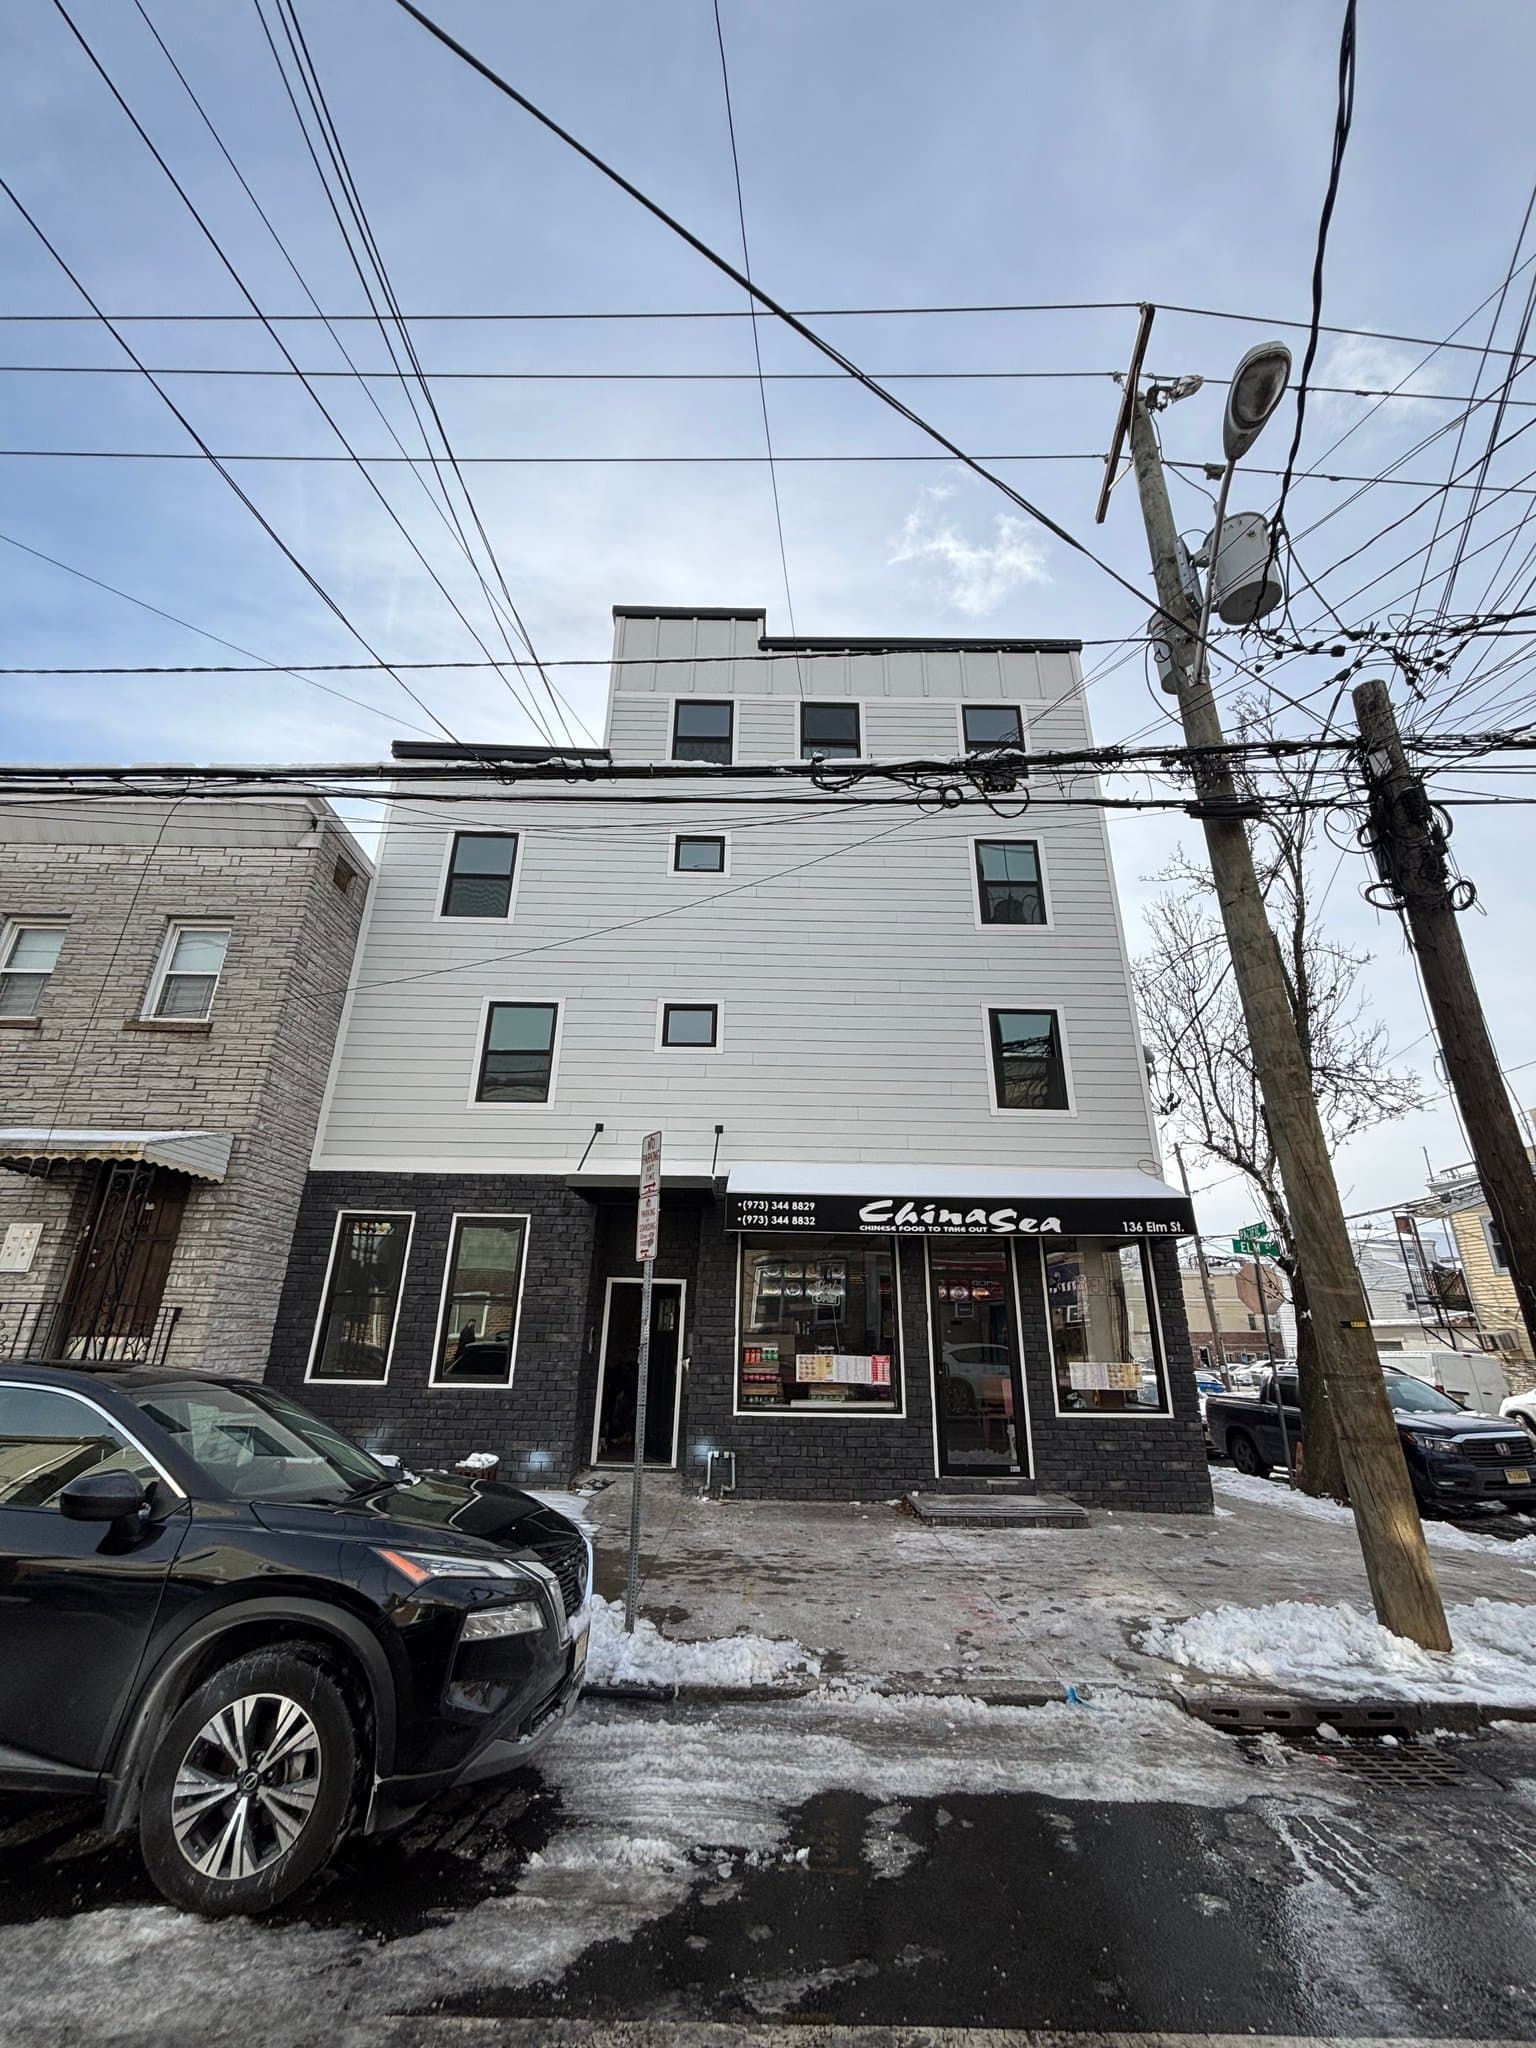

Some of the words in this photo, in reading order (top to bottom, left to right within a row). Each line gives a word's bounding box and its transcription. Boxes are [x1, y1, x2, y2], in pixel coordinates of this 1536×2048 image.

[742, 1200, 769, 1211] (973)
[771, 1201, 789, 1211] 344
[792, 1202, 815, 1211] 8829
[742, 1215, 769, 1226] (973)
[771, 1215, 789, 1225] 344
[792, 1216, 816, 1226] 8832
[1122, 1222, 1143, 1232] 136
[1147, 1222, 1168, 1232] Elm
[1170, 1222, 1185, 1233] St.
[1240, 1241, 1261, 1253] ELM
